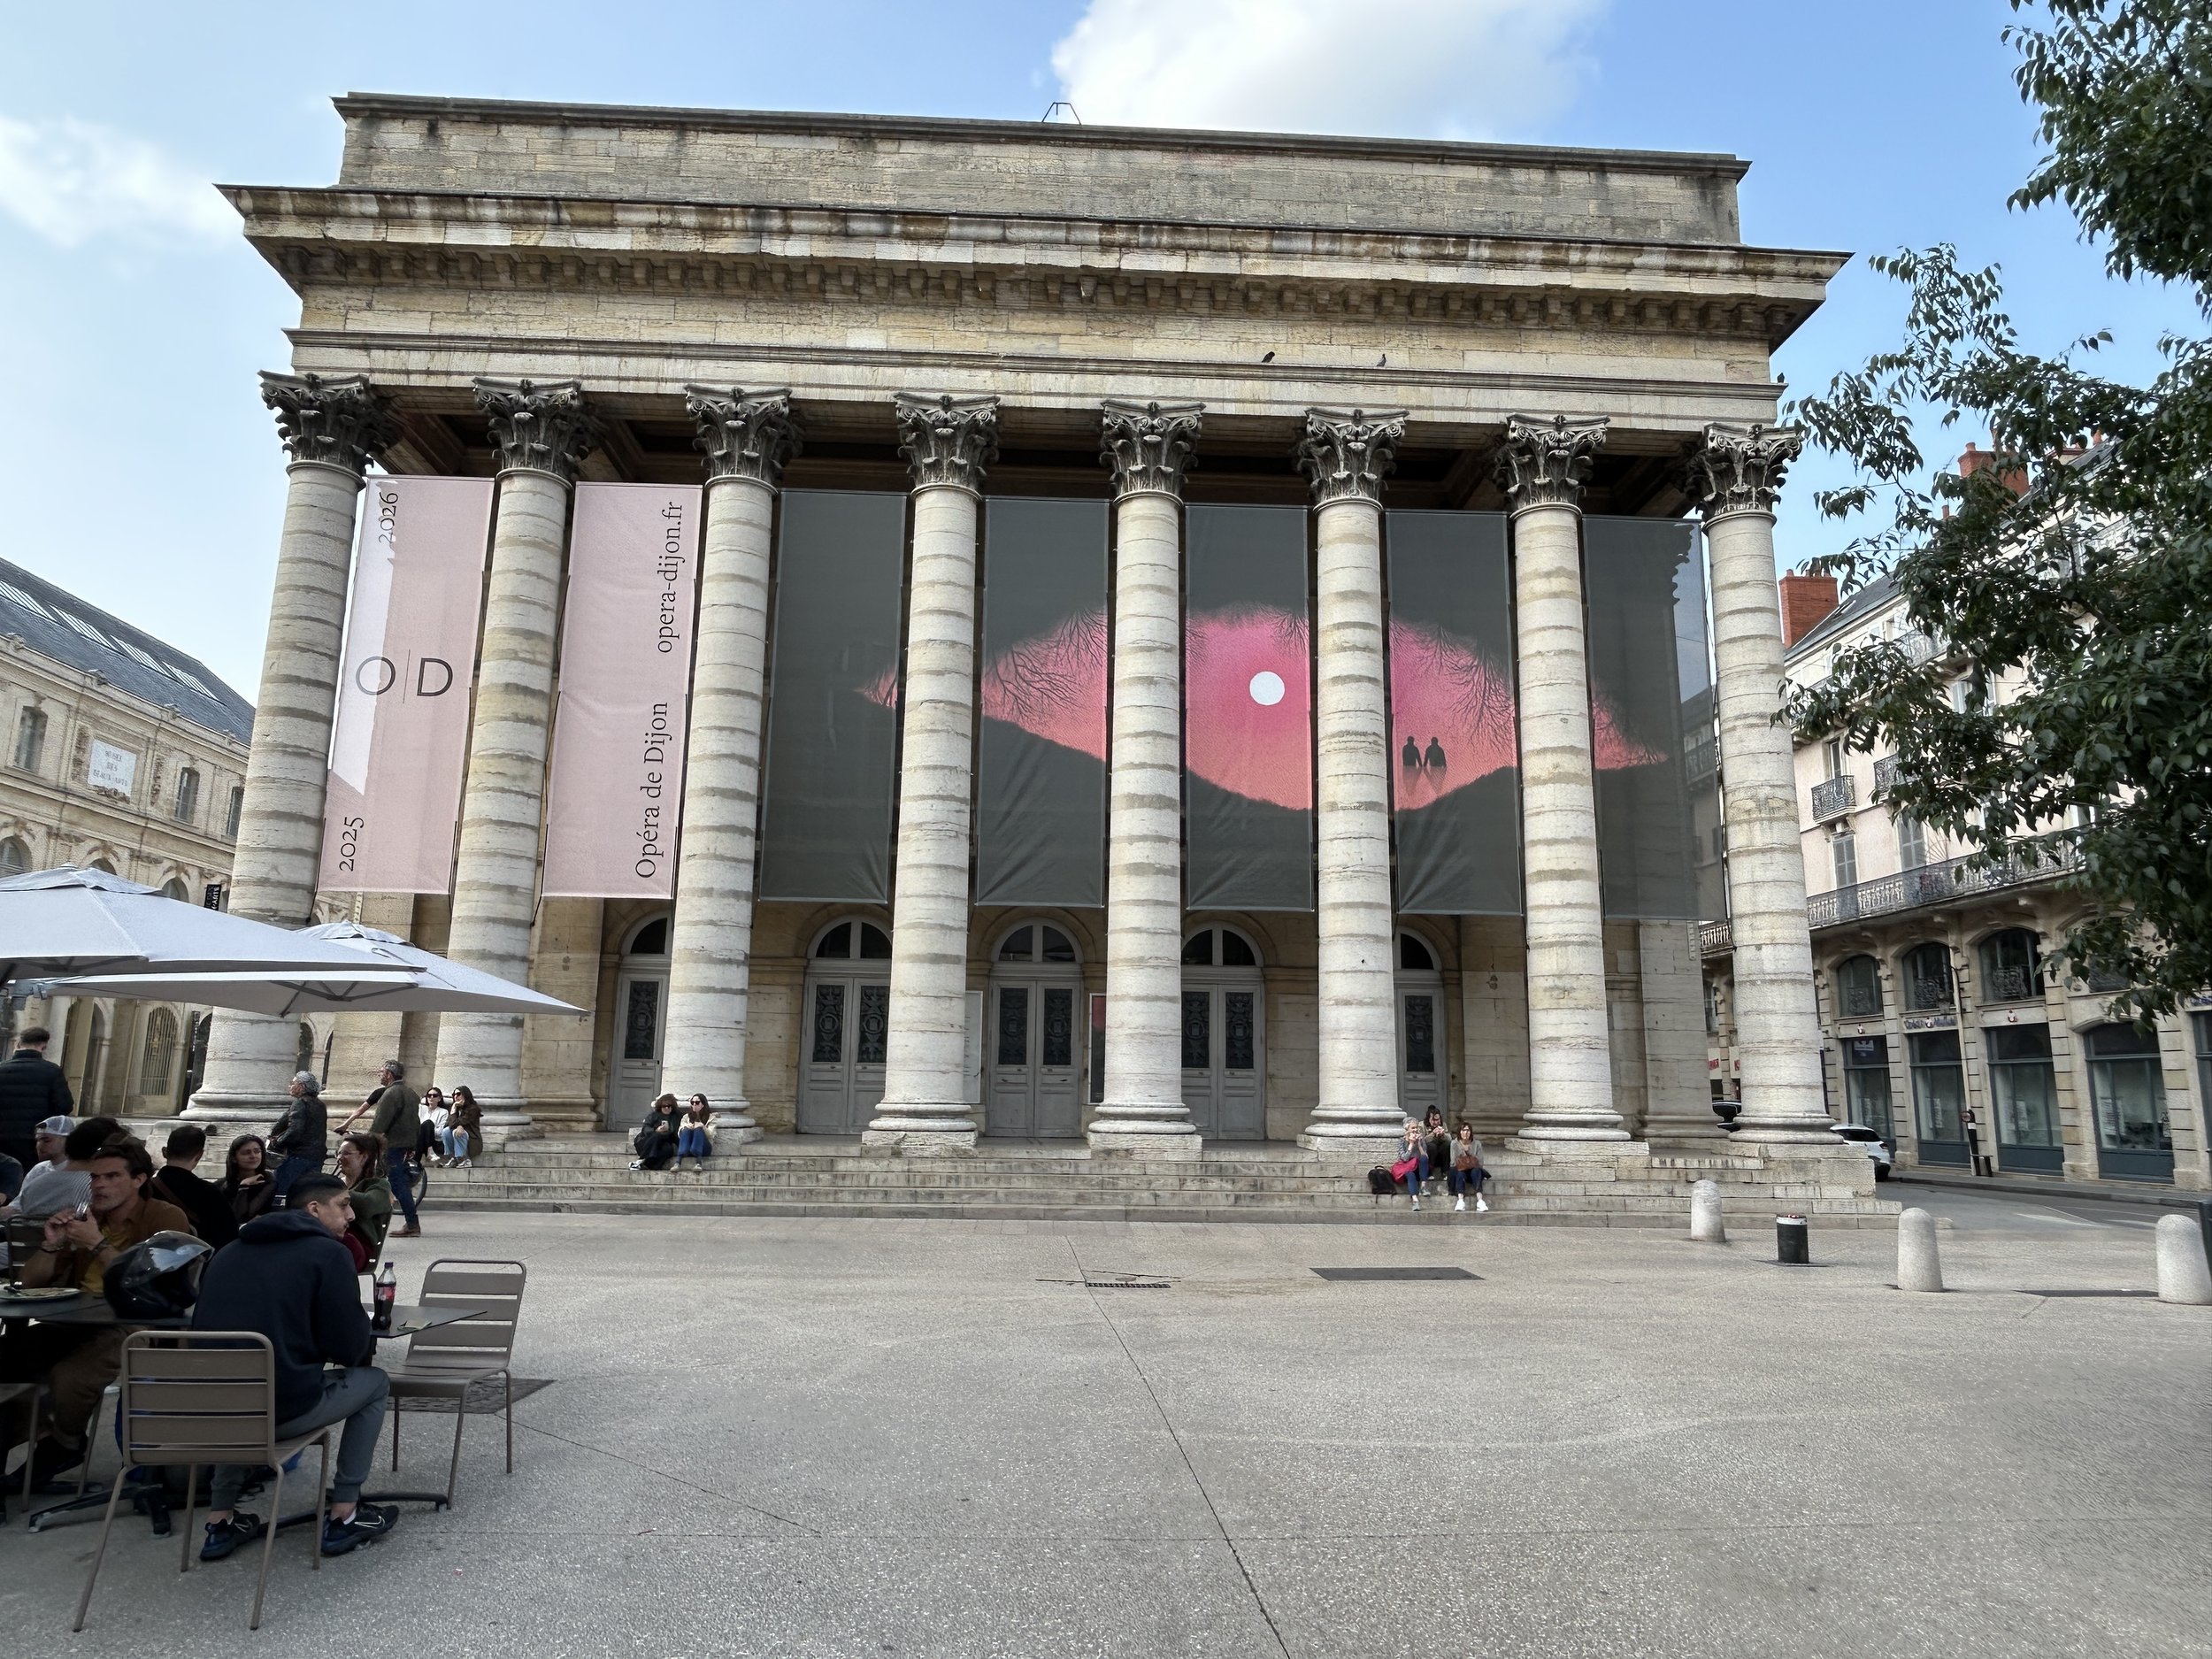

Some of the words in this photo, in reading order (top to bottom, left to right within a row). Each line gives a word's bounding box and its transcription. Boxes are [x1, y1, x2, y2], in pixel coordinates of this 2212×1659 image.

[378, 491, 399, 543] 2026
[657, 501, 686, 653] opera-dijon.fr
[643, 702, 672, 764] Dijon
[640, 772, 663, 798] de
[338, 816, 365, 872] 2025
[635, 805, 664, 879] Opéra
